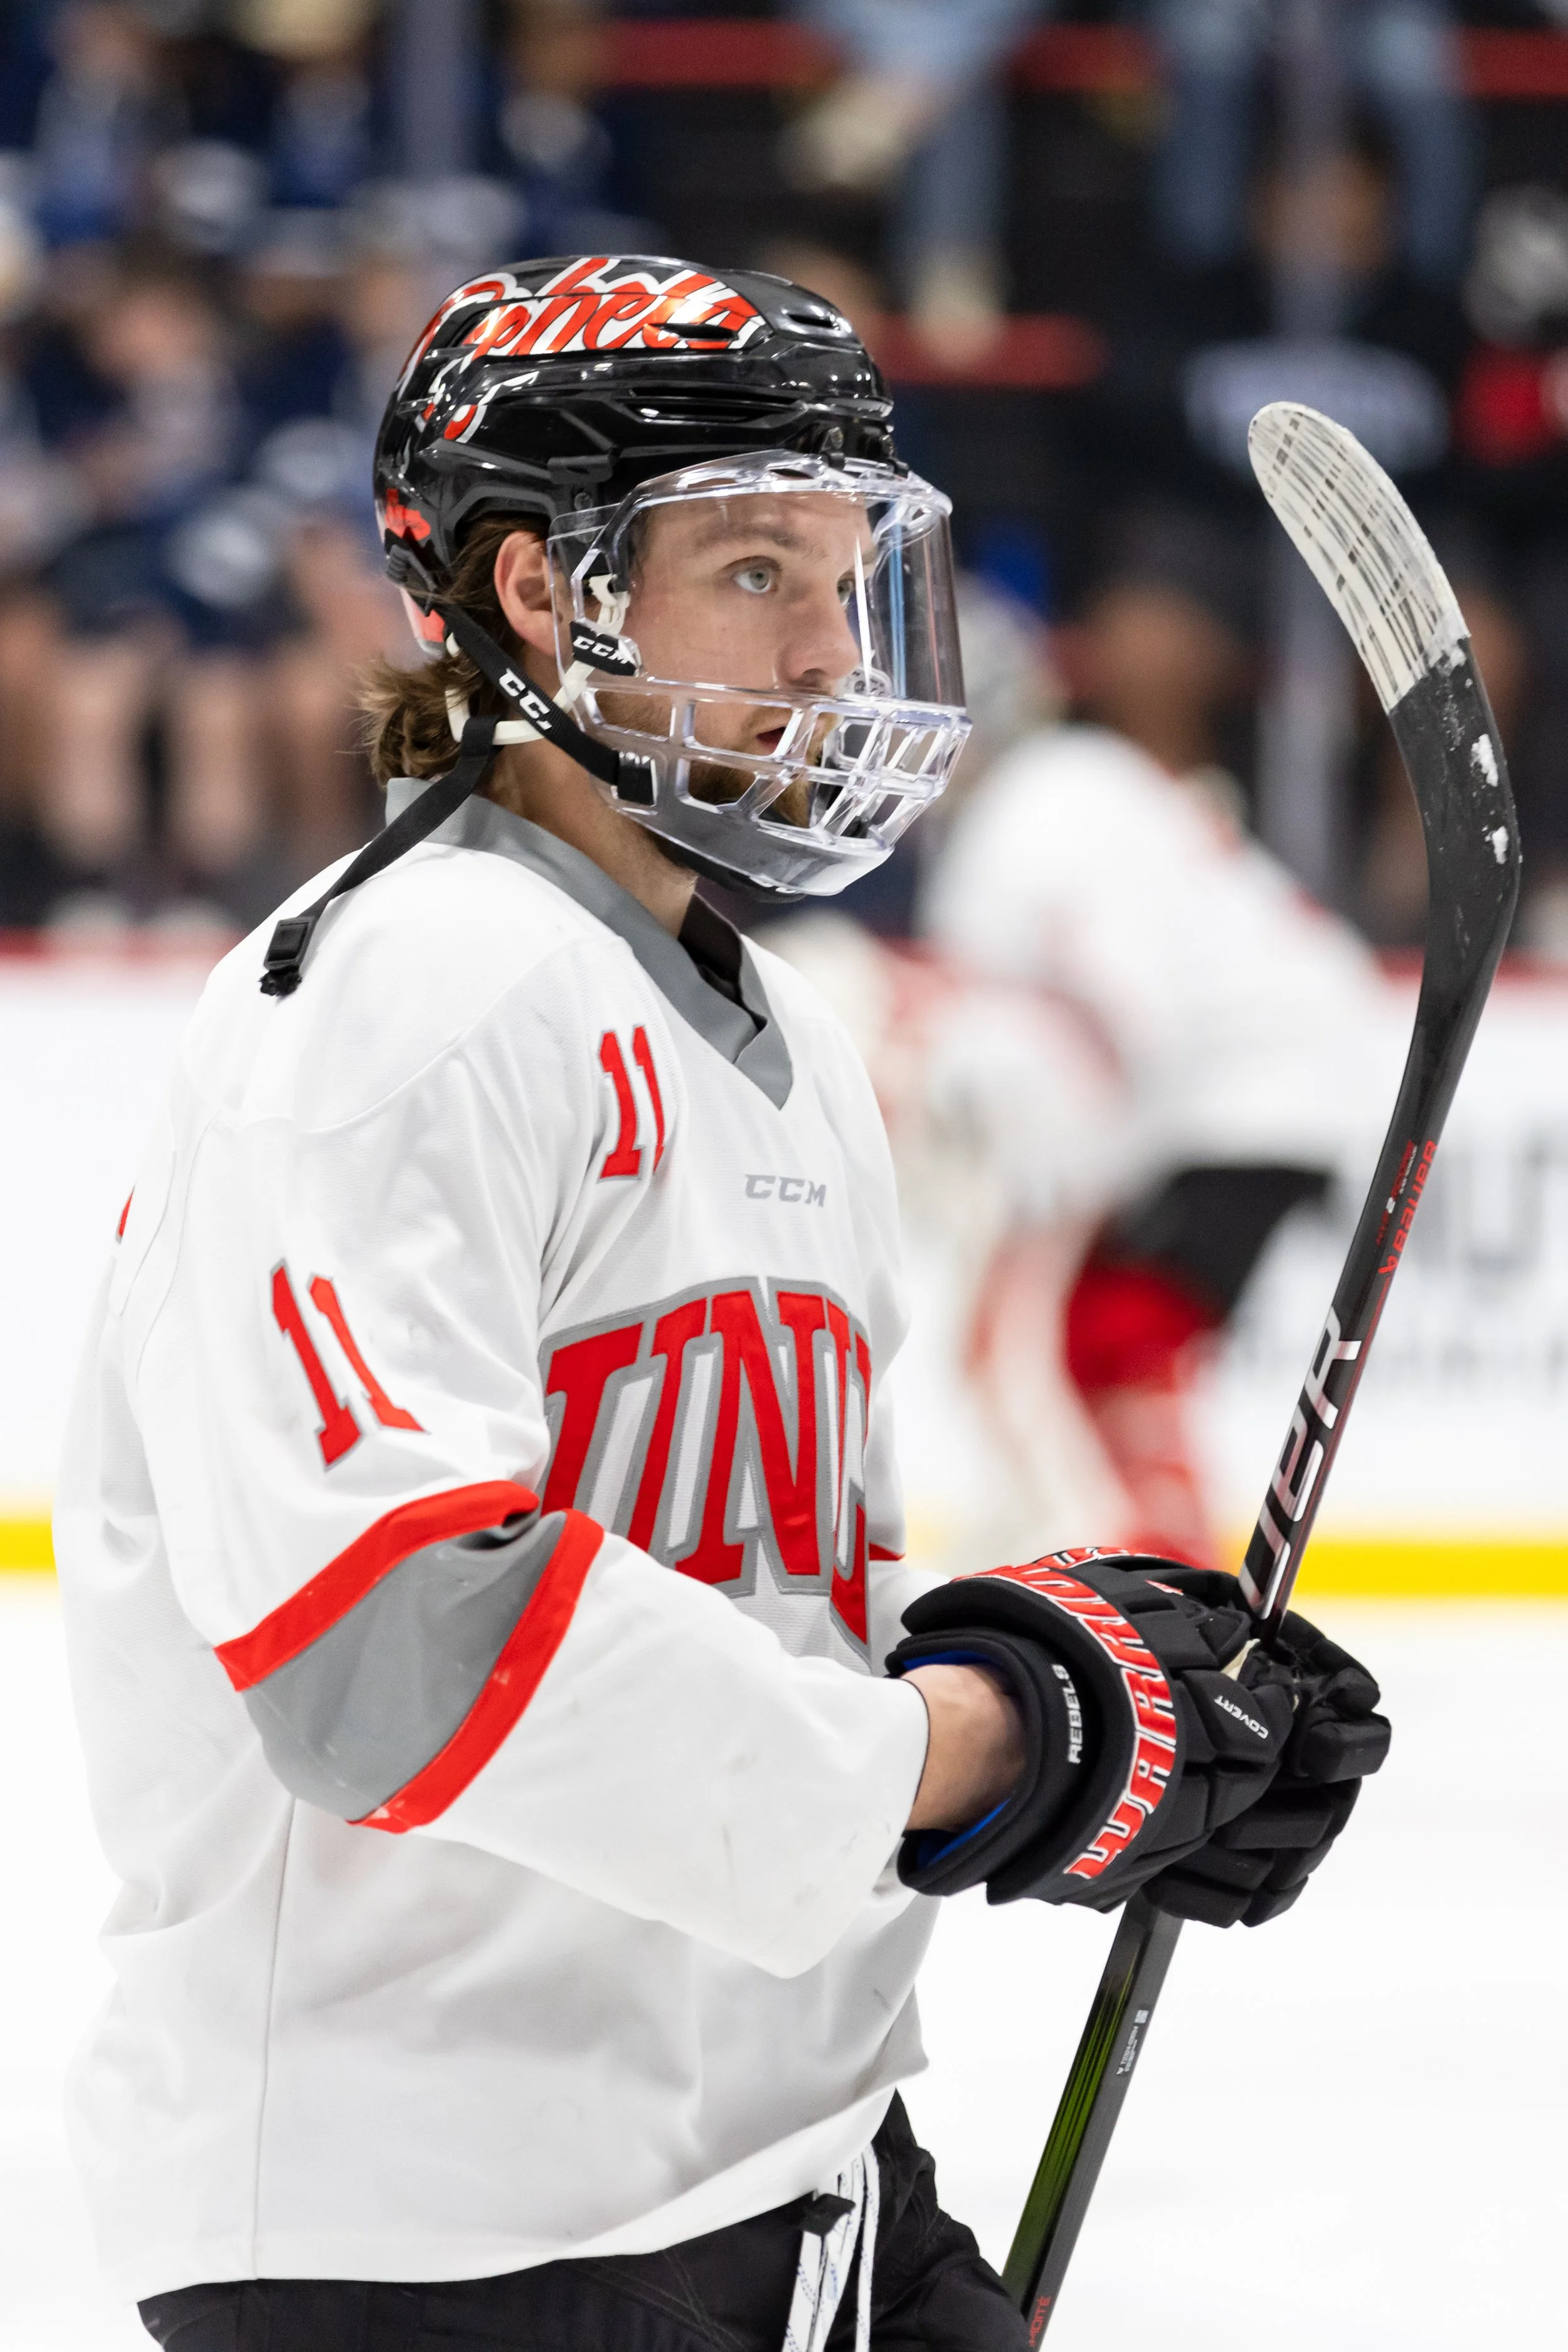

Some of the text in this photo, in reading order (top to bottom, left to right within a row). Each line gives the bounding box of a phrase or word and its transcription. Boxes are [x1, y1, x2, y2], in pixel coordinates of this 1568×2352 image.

[573, 635, 635, 664] CCM
[596, 1024, 666, 1183] 11
[744, 1174, 827, 1207] CCM
[269, 1256, 432, 1472] 11
[950, 1564, 1177, 1880] WARRIO
[1051, 1663, 1083, 1764] REBELS
[1214, 1694, 1269, 1740] COVERT
